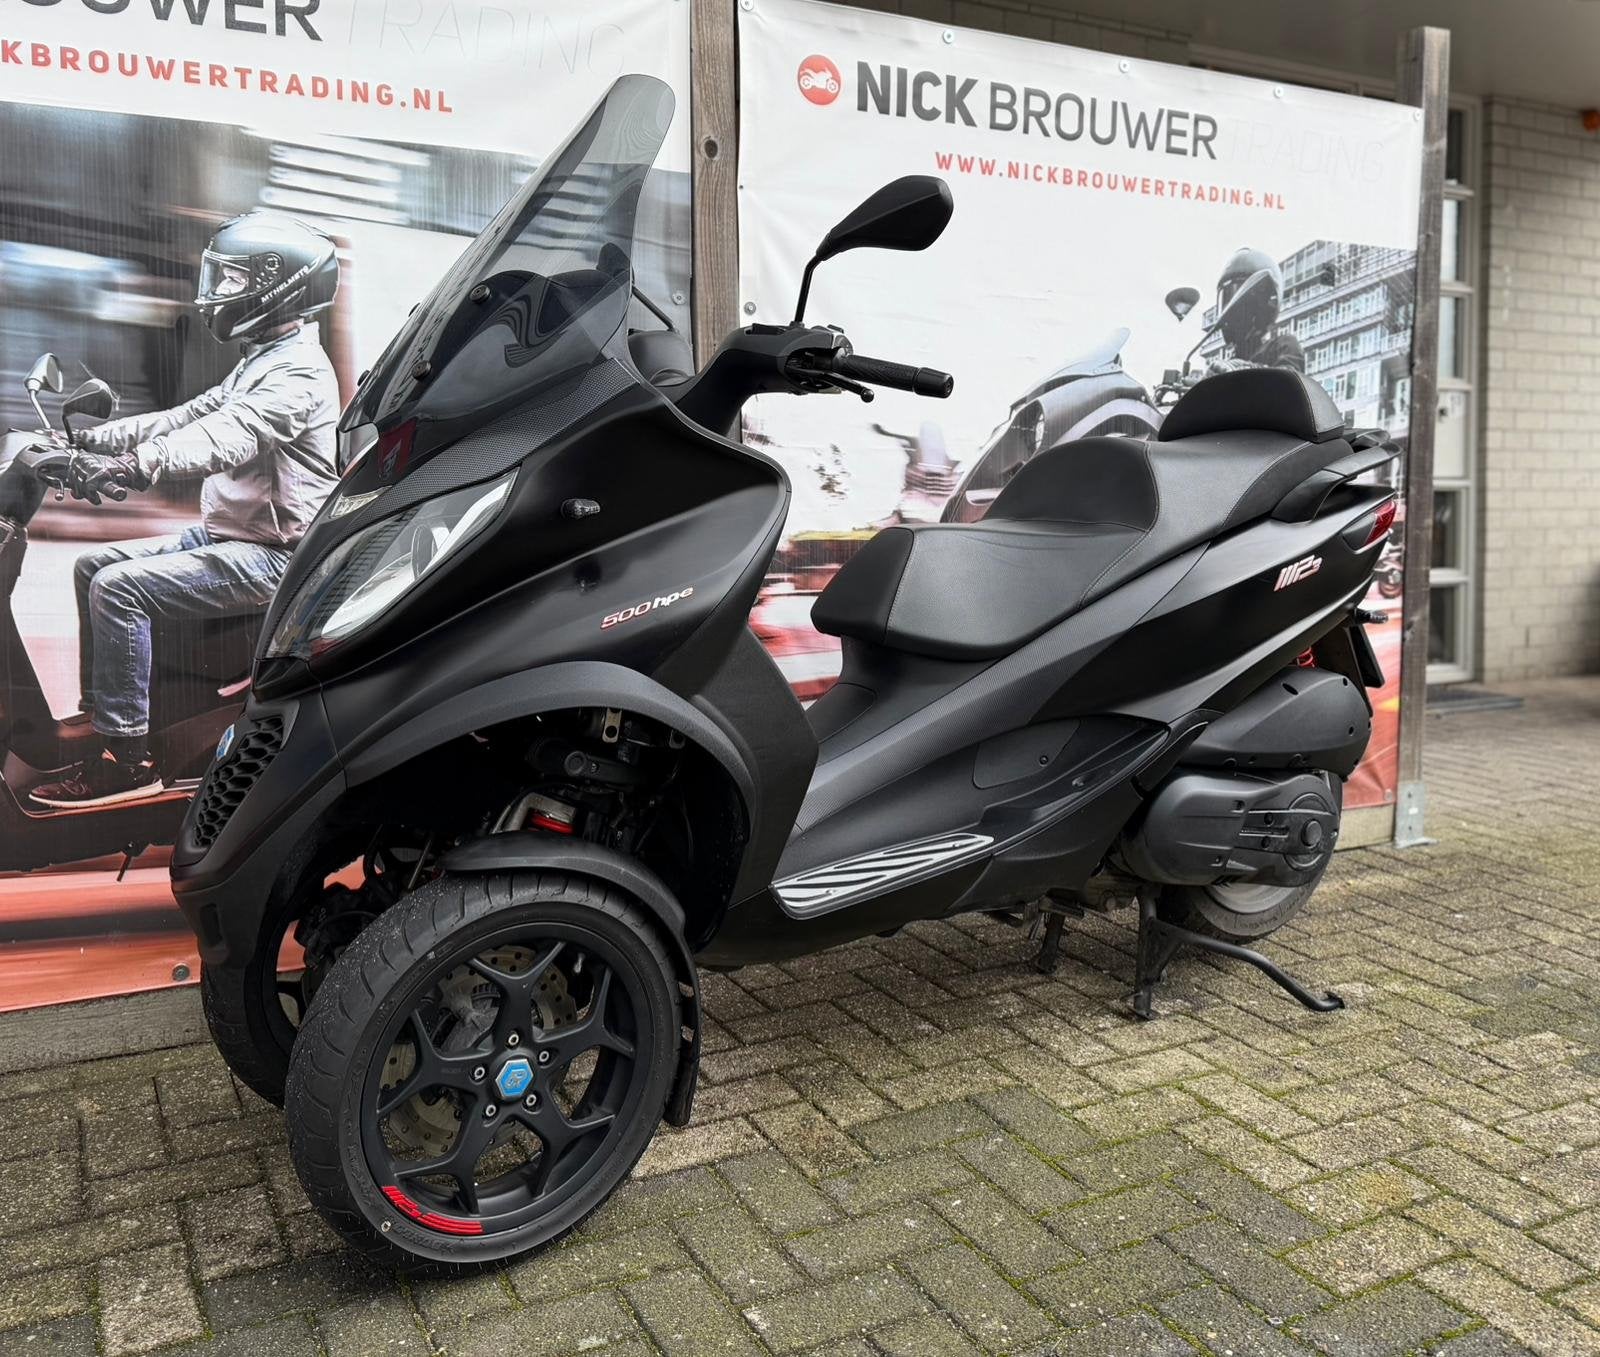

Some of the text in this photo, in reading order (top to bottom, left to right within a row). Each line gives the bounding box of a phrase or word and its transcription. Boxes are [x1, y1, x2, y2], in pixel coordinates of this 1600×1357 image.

[1, 39, 453, 113] KBROUWERTRADING.NL
[856, 60, 978, 128] NICK
[988, 81, 1218, 159] BROUWER
[935, 151, 1286, 210] WWW.NICKBROUWERTRADING.NL
